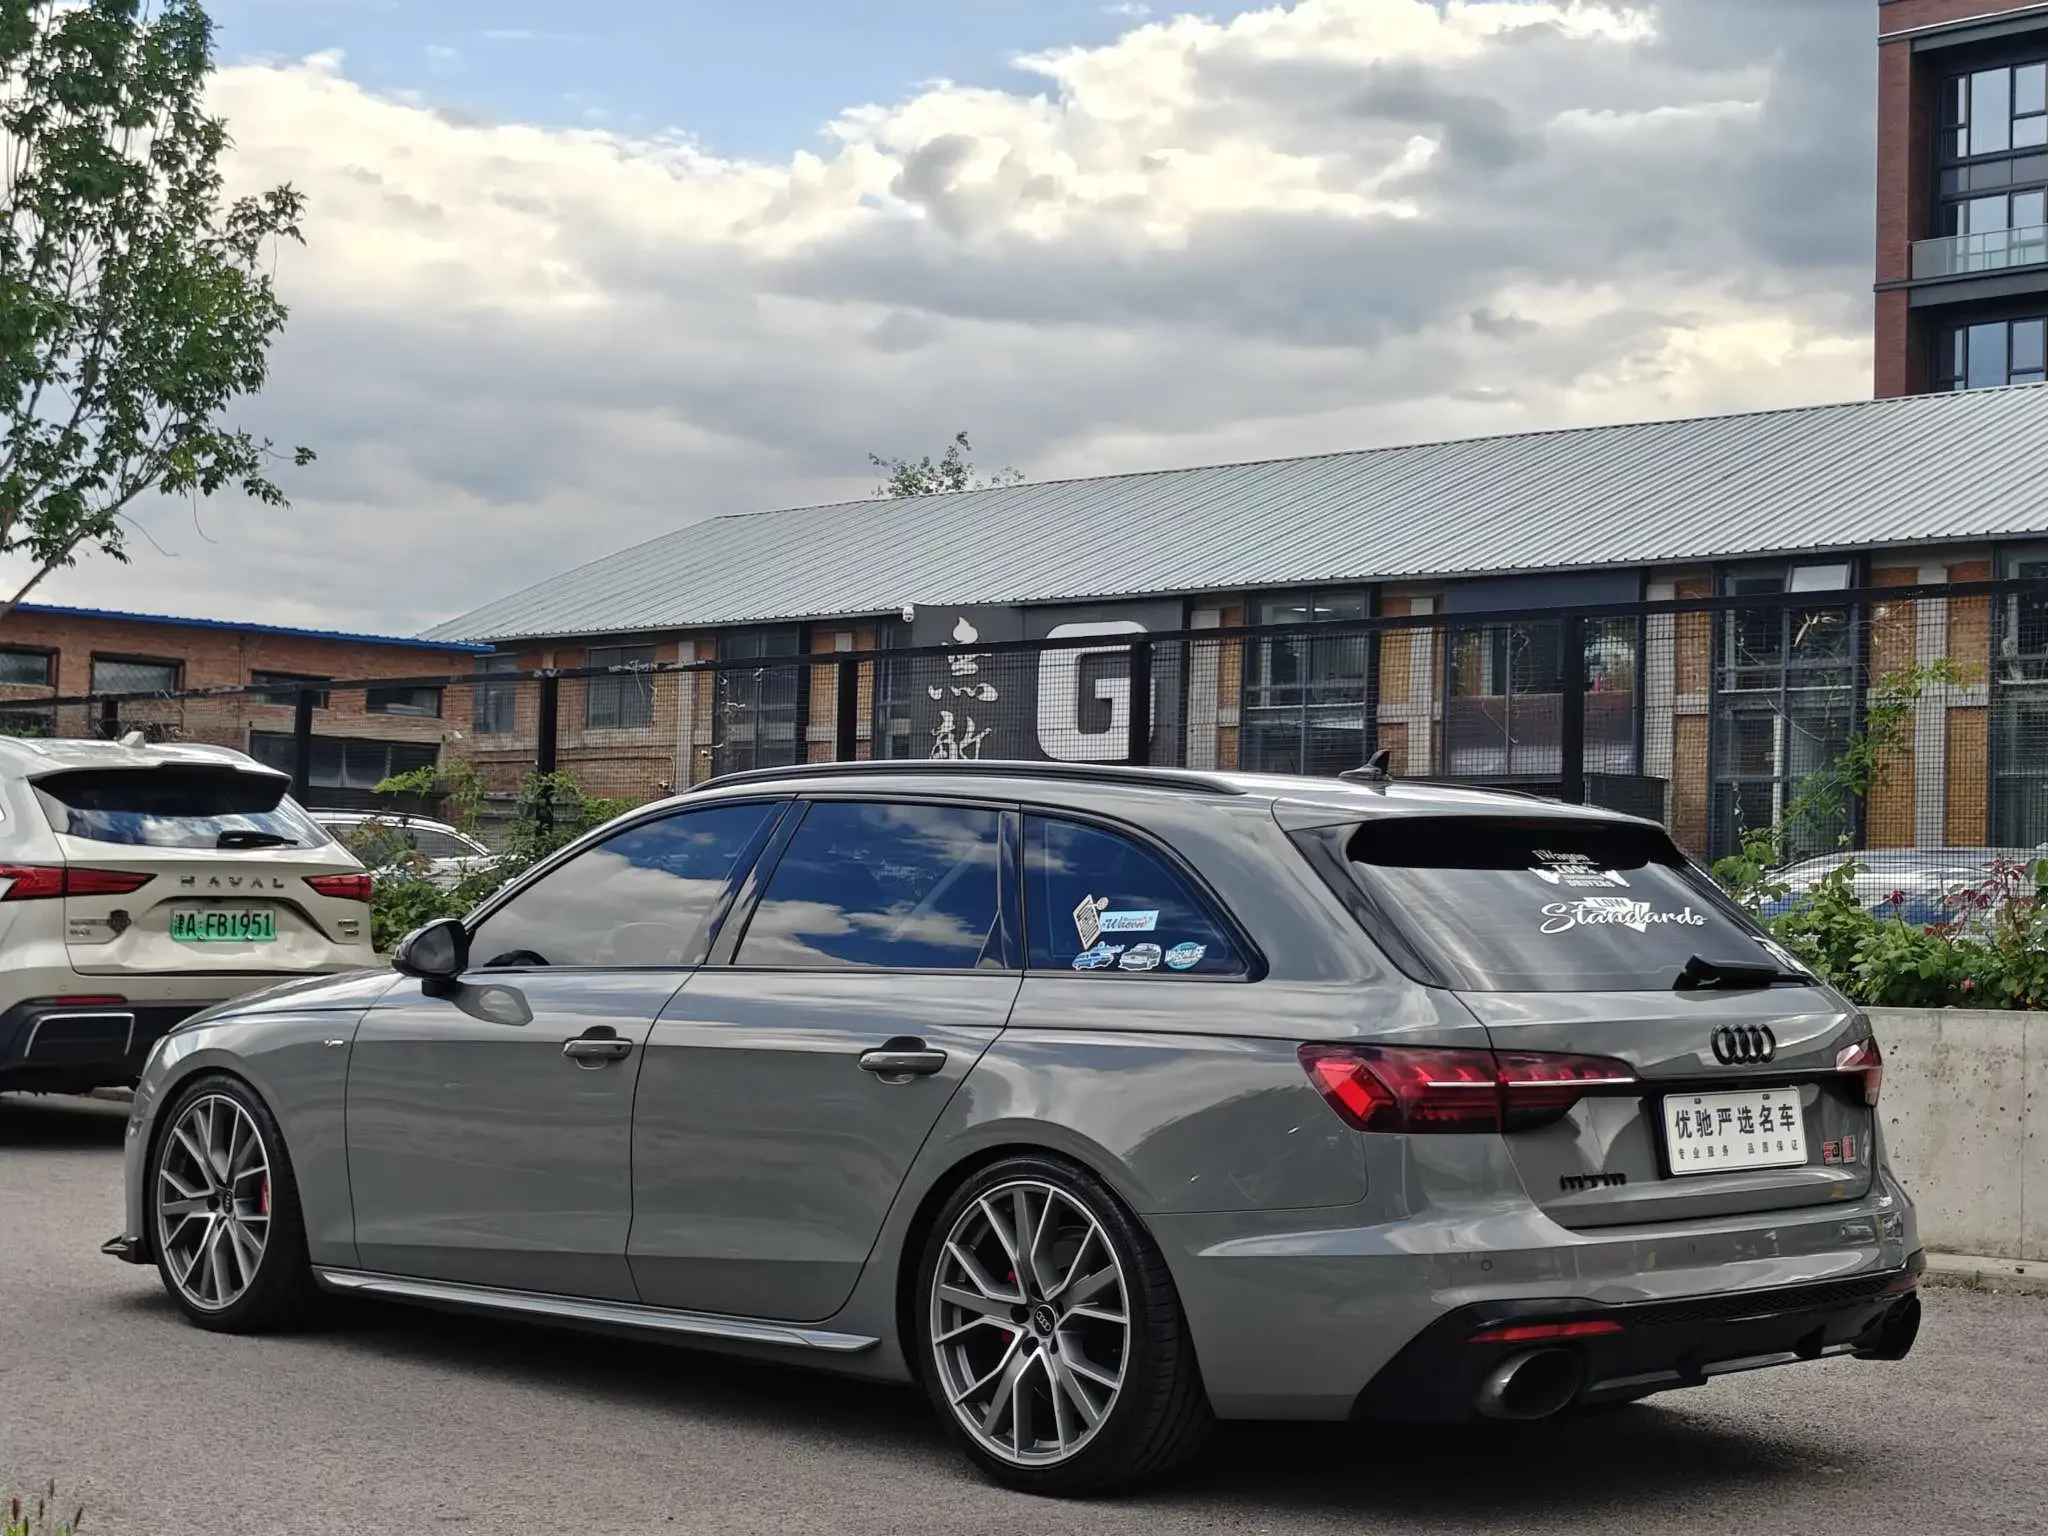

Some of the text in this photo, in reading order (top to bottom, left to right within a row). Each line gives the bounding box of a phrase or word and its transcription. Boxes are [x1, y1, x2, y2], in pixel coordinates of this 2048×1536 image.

[1037, 620, 1156, 761] G
[1552, 864, 1597, 875] 100%
[180, 875, 285, 889] HAVAL
[1594, 898, 1628, 908] LOW
[1540, 901, 1708, 934] Standards
[1675, 1103, 1796, 1140] 优驰严选名车
